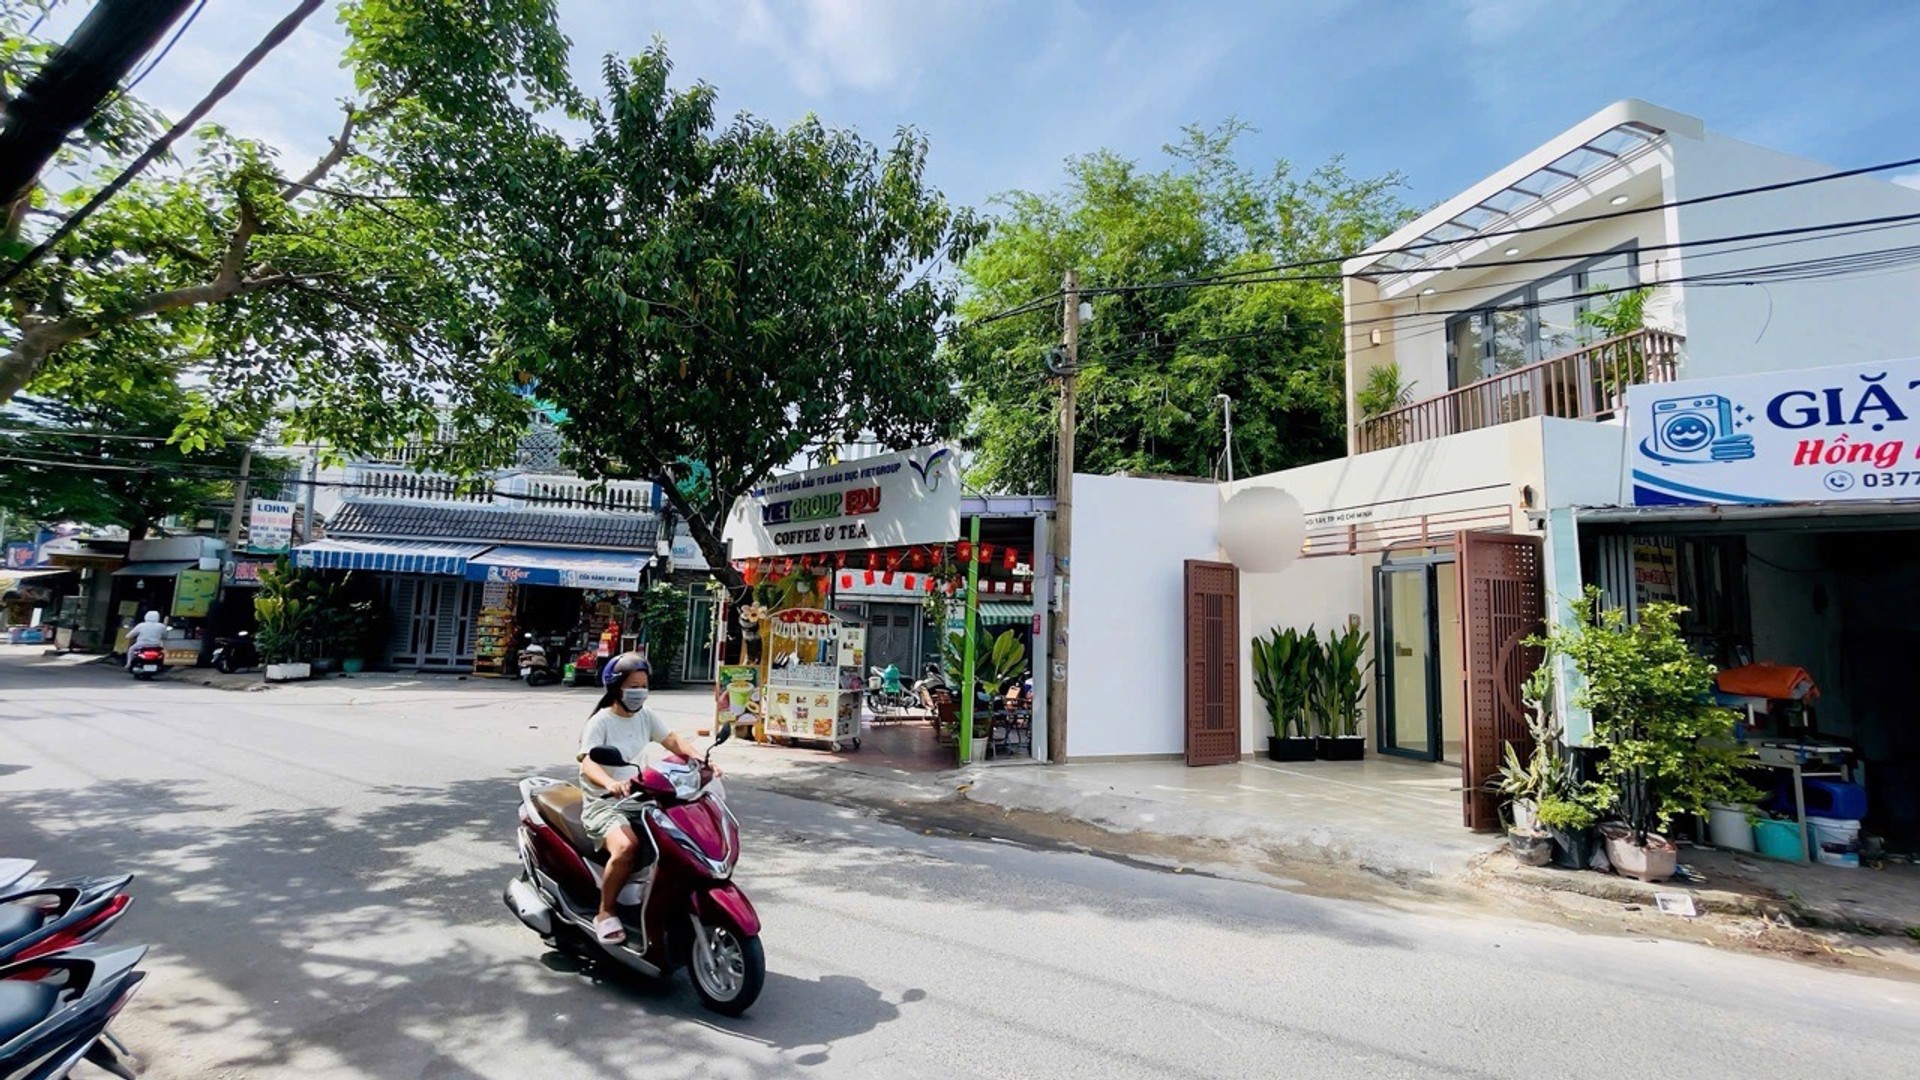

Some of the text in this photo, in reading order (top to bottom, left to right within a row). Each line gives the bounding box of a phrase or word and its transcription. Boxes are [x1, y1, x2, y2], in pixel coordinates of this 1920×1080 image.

[1766, 371, 1920, 432] GIẶ
[1794, 433, 1904, 469] Hồng
[774, 523, 869, 546] COFFEE & TEA
[500, 567, 531, 582] Tiger
